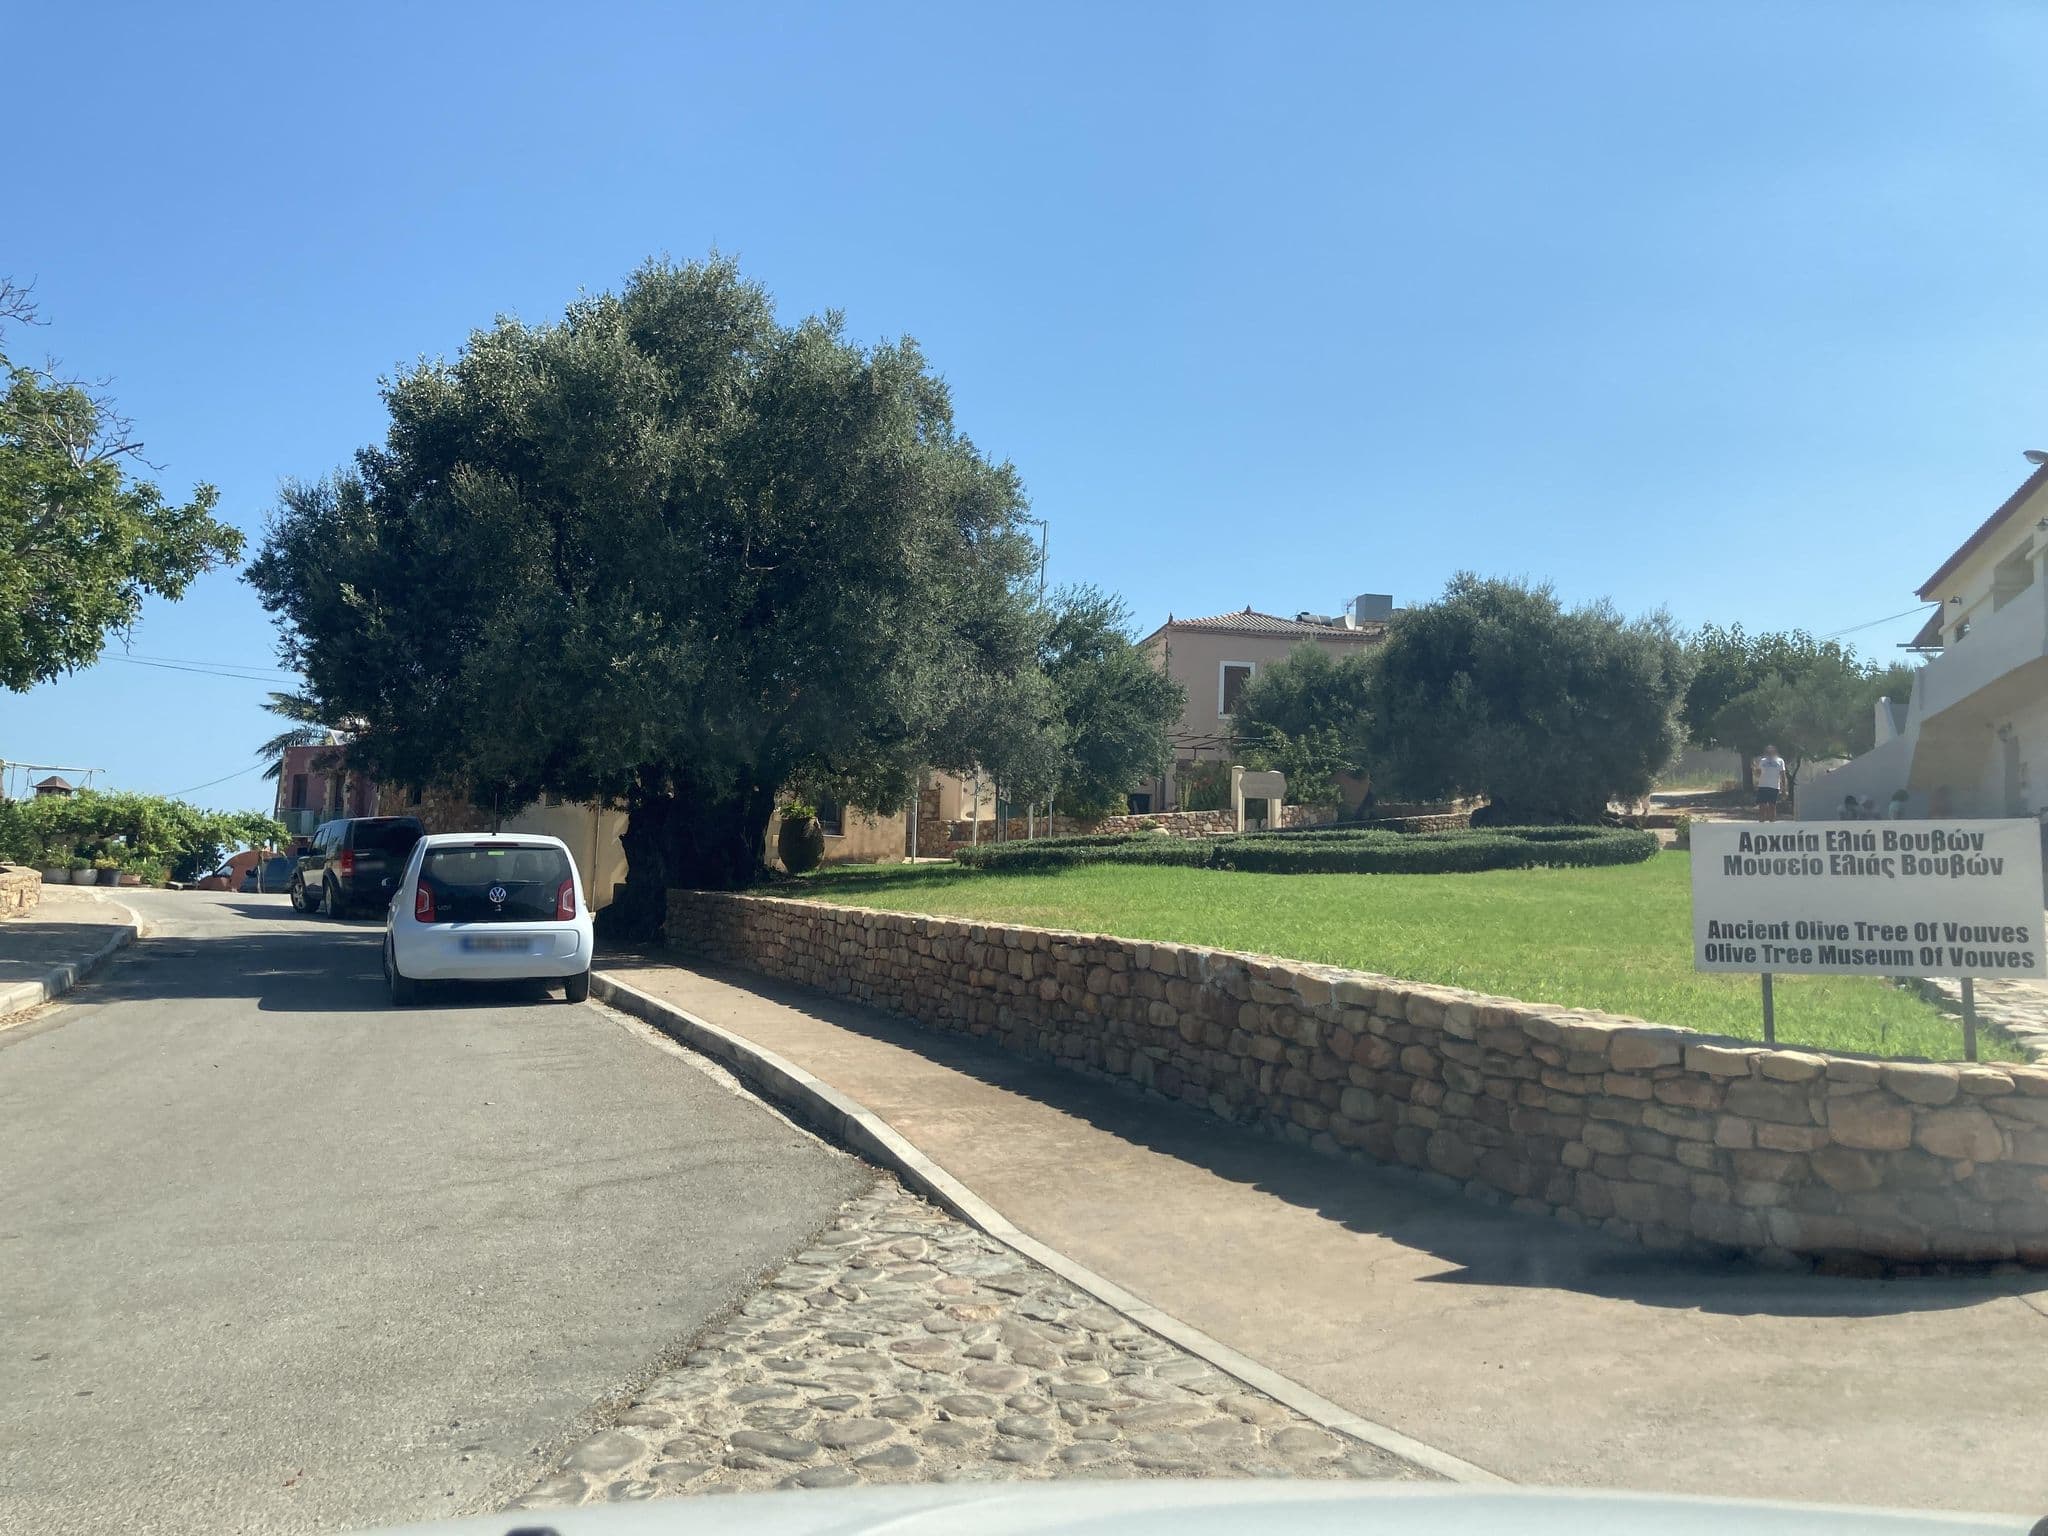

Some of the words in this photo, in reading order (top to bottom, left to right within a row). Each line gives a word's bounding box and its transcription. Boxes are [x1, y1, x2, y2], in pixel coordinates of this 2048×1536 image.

[1738, 831, 1819, 854] Αρχαία
[1826, 830, 1876, 851] Ελιά
[1883, 829, 1984, 853] Βουβών
[1723, 853, 1823, 876] Μουσείο
[1830, 854, 1895, 878] Ελιάς
[1901, 853, 2003, 878] Βουβών
[1708, 920, 1790, 940] Ancient
[1795, 921, 1849, 941] Olive
[1854, 922, 1908, 942] Tree
[1914, 922, 1938, 943] Of
[1943, 923, 2029, 943] Vouves
[1705, 943, 1756, 964] Olive
[1761, 944, 1812, 965] Tree
[1819, 945, 1913, 967] Museum
[1920, 946, 1944, 967] Of
[1950, 948, 2035, 968] Vouves
